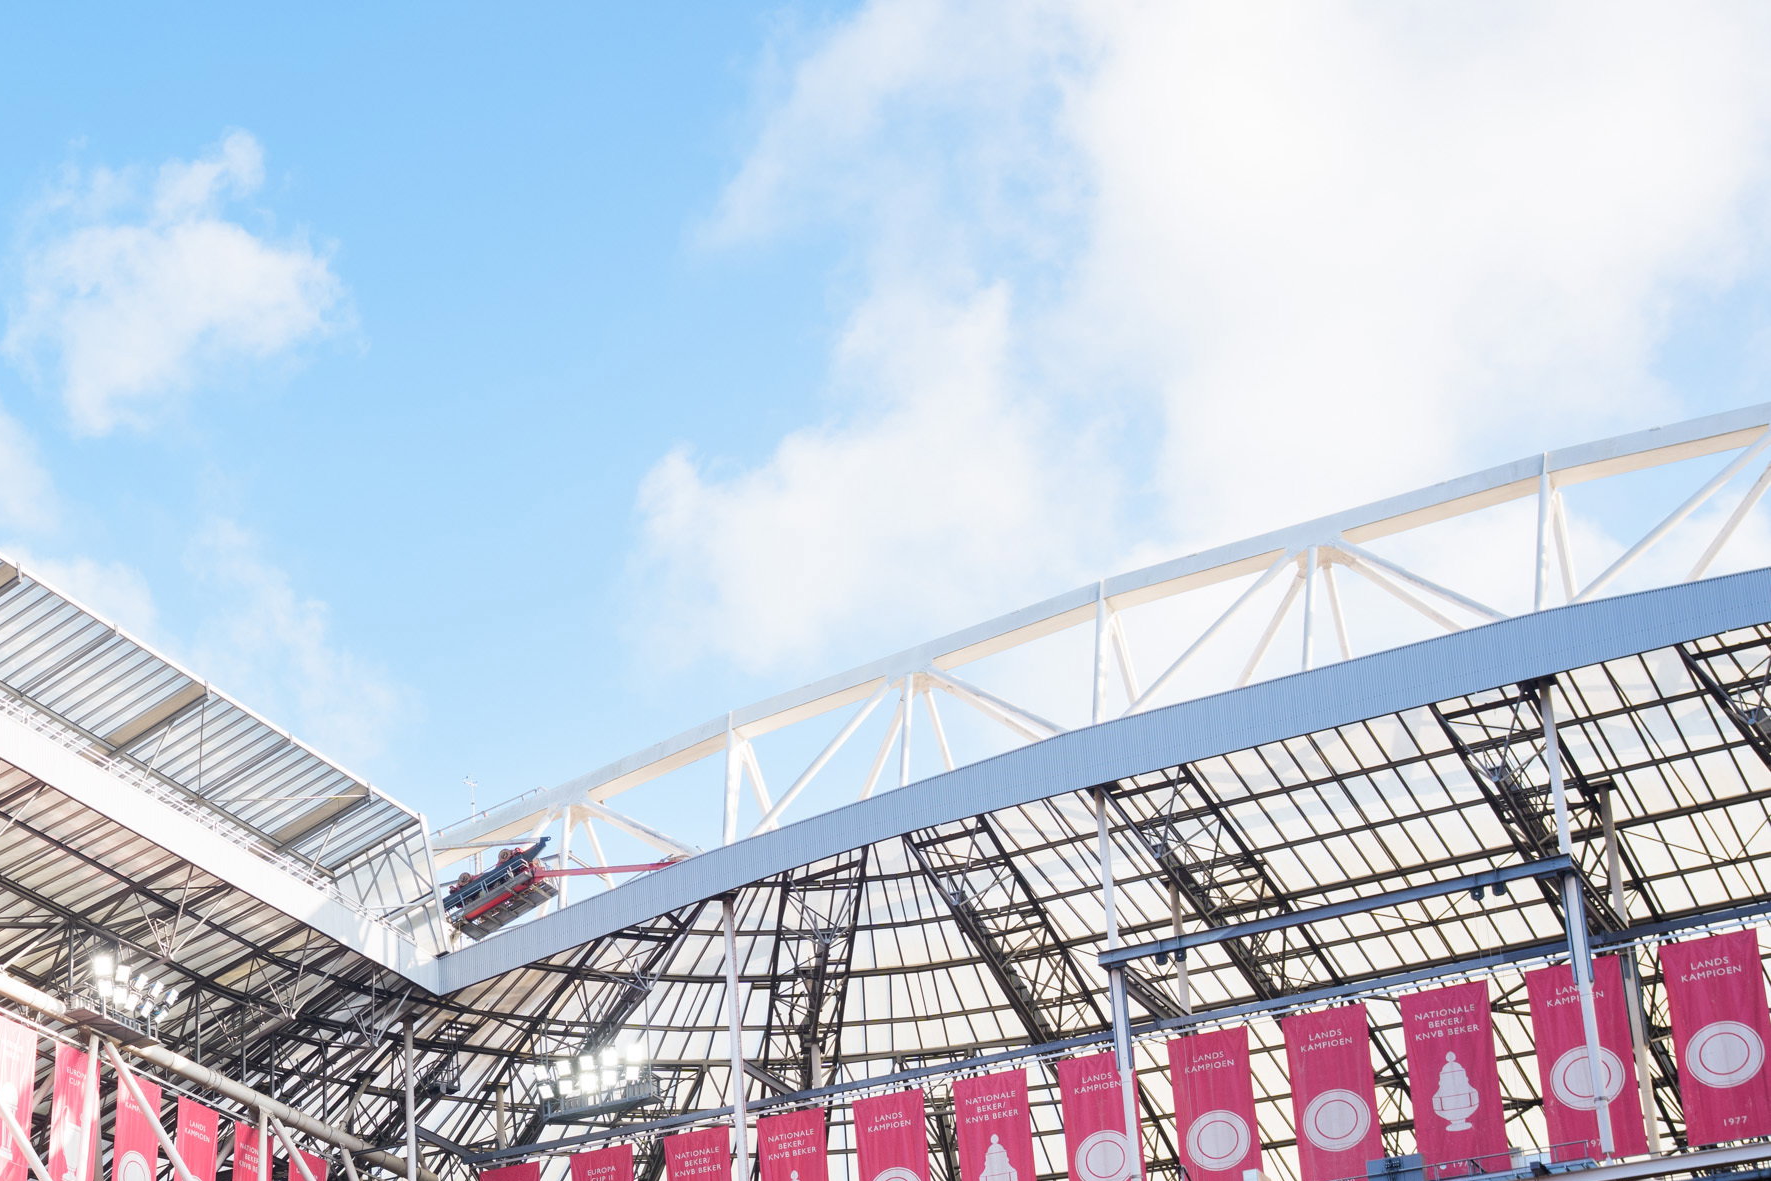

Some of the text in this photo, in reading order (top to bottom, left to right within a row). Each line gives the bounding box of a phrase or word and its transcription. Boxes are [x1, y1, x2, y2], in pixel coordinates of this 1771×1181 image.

[1690, 956, 1729, 970] LANDS
[1681, 965, 1742, 983] KAMPIOEN
[1555, 984, 1579, 996] LAN
[1546, 990, 1604, 1007] KAMPIEN
[1414, 1004, 1475, 1020] NATIONALE
[1428, 1017, 1463, 1028] BEKER/
[1309, 1028, 1342, 1041] LANDS
[1415, 1024, 1479, 1041] KNVB BEKER
[1300, 1037, 1352, 1052] KAMPIOEN
[1192, 1051, 1224, 1062] LANDS
[1184, 1059, 1234, 1074] KAMPIOEN
[1081, 1071, 1113, 1084] LANDS
[1074, 1080, 1121, 1094] KAMPIOEN
[965, 1090, 1016, 1105] NATIONALE
[976, 1101, 1006, 1112] BEKER/
[874, 1111, 903, 1122] LANDS
[965, 1109, 1018, 1124] KNVB BEKER
[1723, 1116, 1748, 1126] 1977
[189, 1119, 206, 1132] LANDS
[867, 1119, 911, 1133] KAMPIOEN
[184, 1127, 210, 1143] KAMPIOEN
[767, 1128, 814, 1142] NATIONALE
[778, 1139, 805, 1150] BEKER/
[674, 1146, 720, 1160] NATIONALE
[768, 1146, 816, 1161] KNVB BEKER
[684, 1156, 710, 1167] BEKER/
[587, 1165, 616, 1176] EUROPA
[674, 1163, 721, 1177] KNVB BEKER
